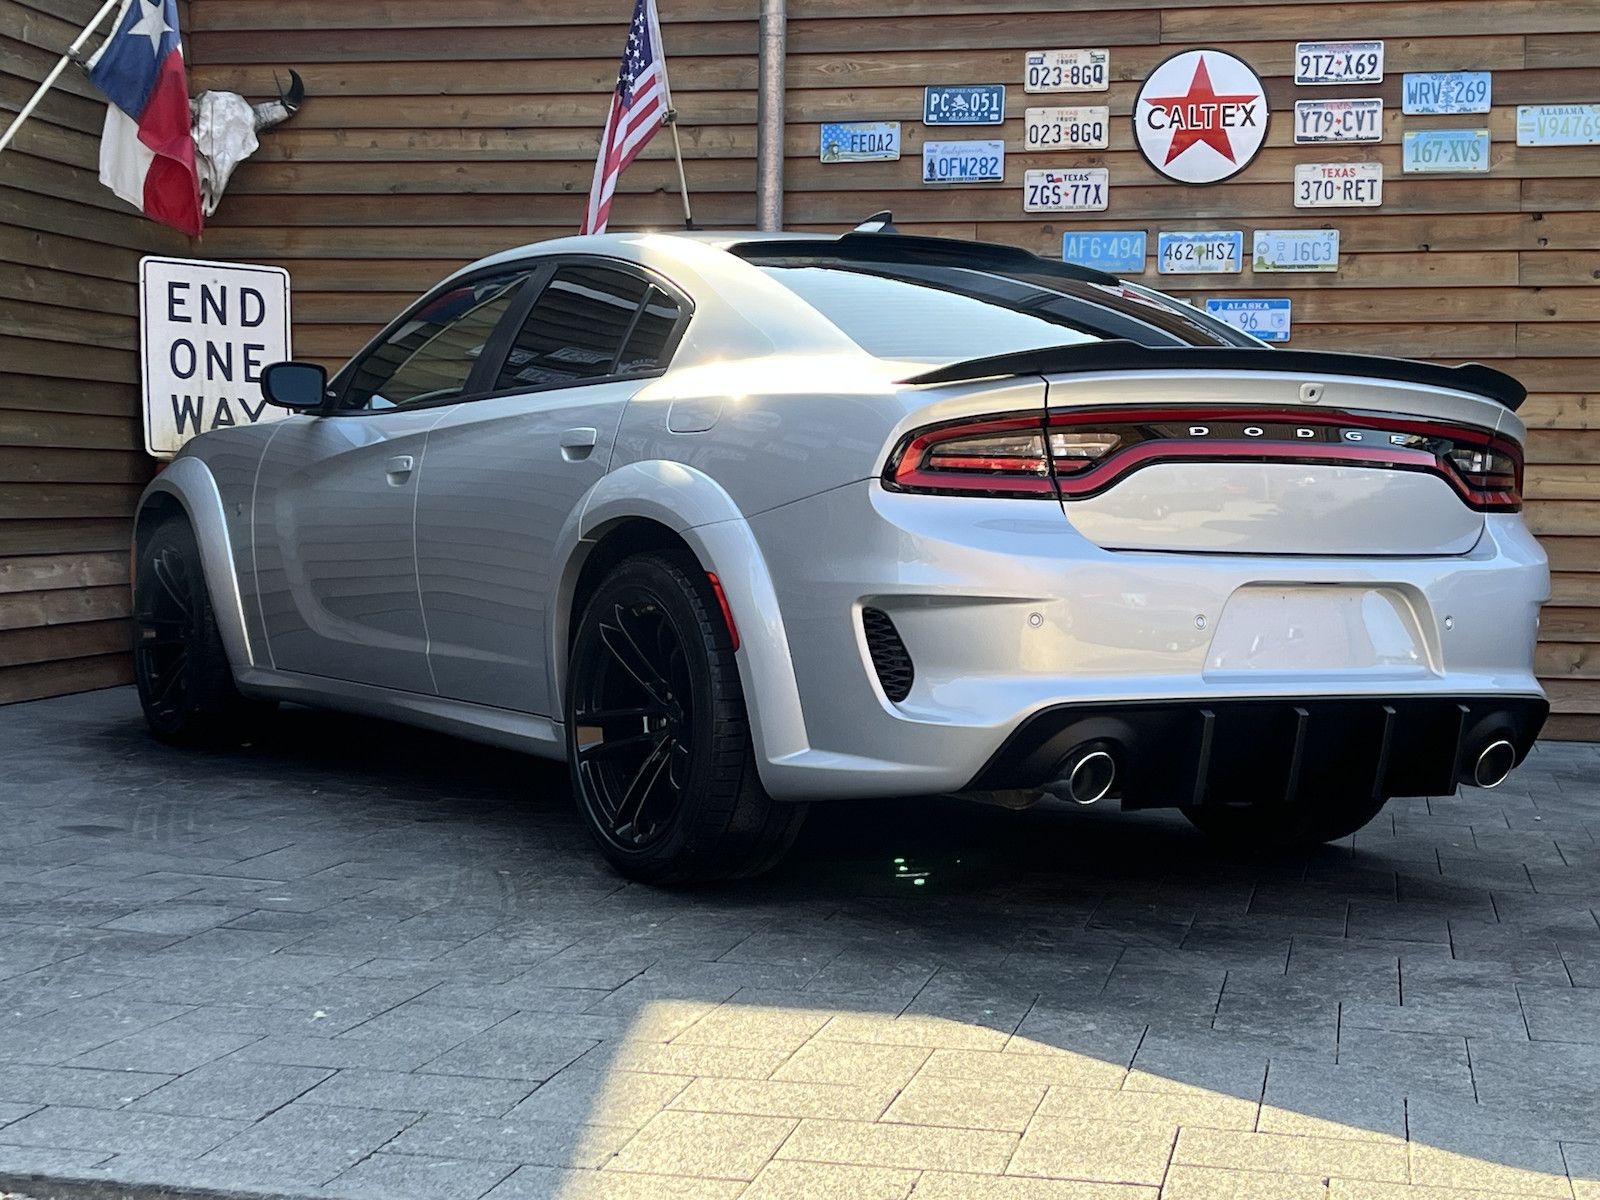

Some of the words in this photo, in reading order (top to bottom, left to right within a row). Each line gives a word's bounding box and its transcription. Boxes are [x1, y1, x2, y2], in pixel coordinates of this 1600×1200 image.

[1147, 104, 1257, 130] CALTEX
[1063, 173, 1089, 182] TEXAS
[1321, 167, 1357, 178] TEXAS
[167, 281, 266, 328] END
[1226, 302, 1270, 310] ALASKA
[1239, 312, 1258, 330] 96
[169, 338, 265, 383] ONE
[171, 394, 267, 435] WAY
